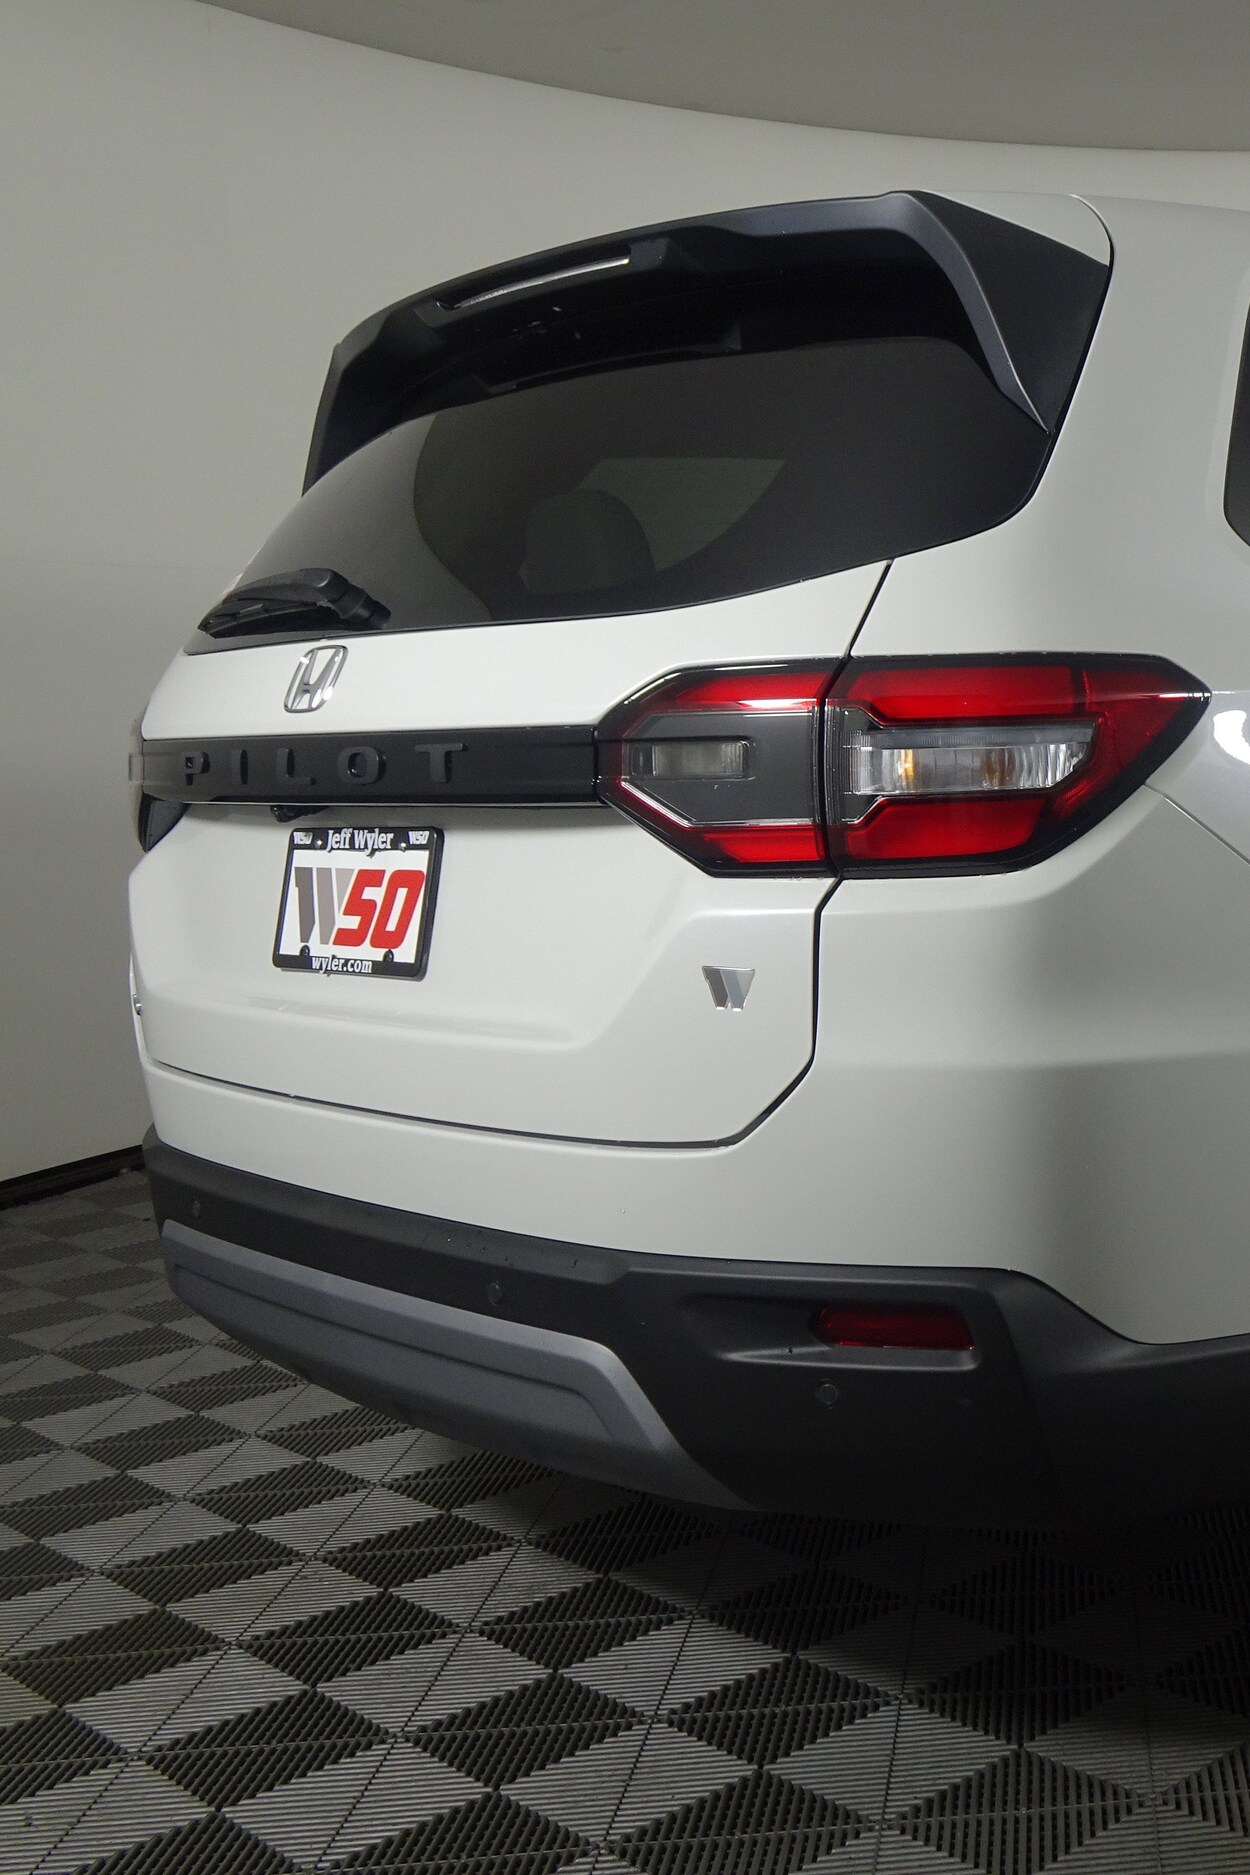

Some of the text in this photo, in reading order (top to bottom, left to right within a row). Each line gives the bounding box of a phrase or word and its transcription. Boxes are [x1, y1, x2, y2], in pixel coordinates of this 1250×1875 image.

[181, 742, 468, 786] PILOT
[326, 828, 394, 856] Jeff Wyler
[311, 955, 373, 977] wyler.com
